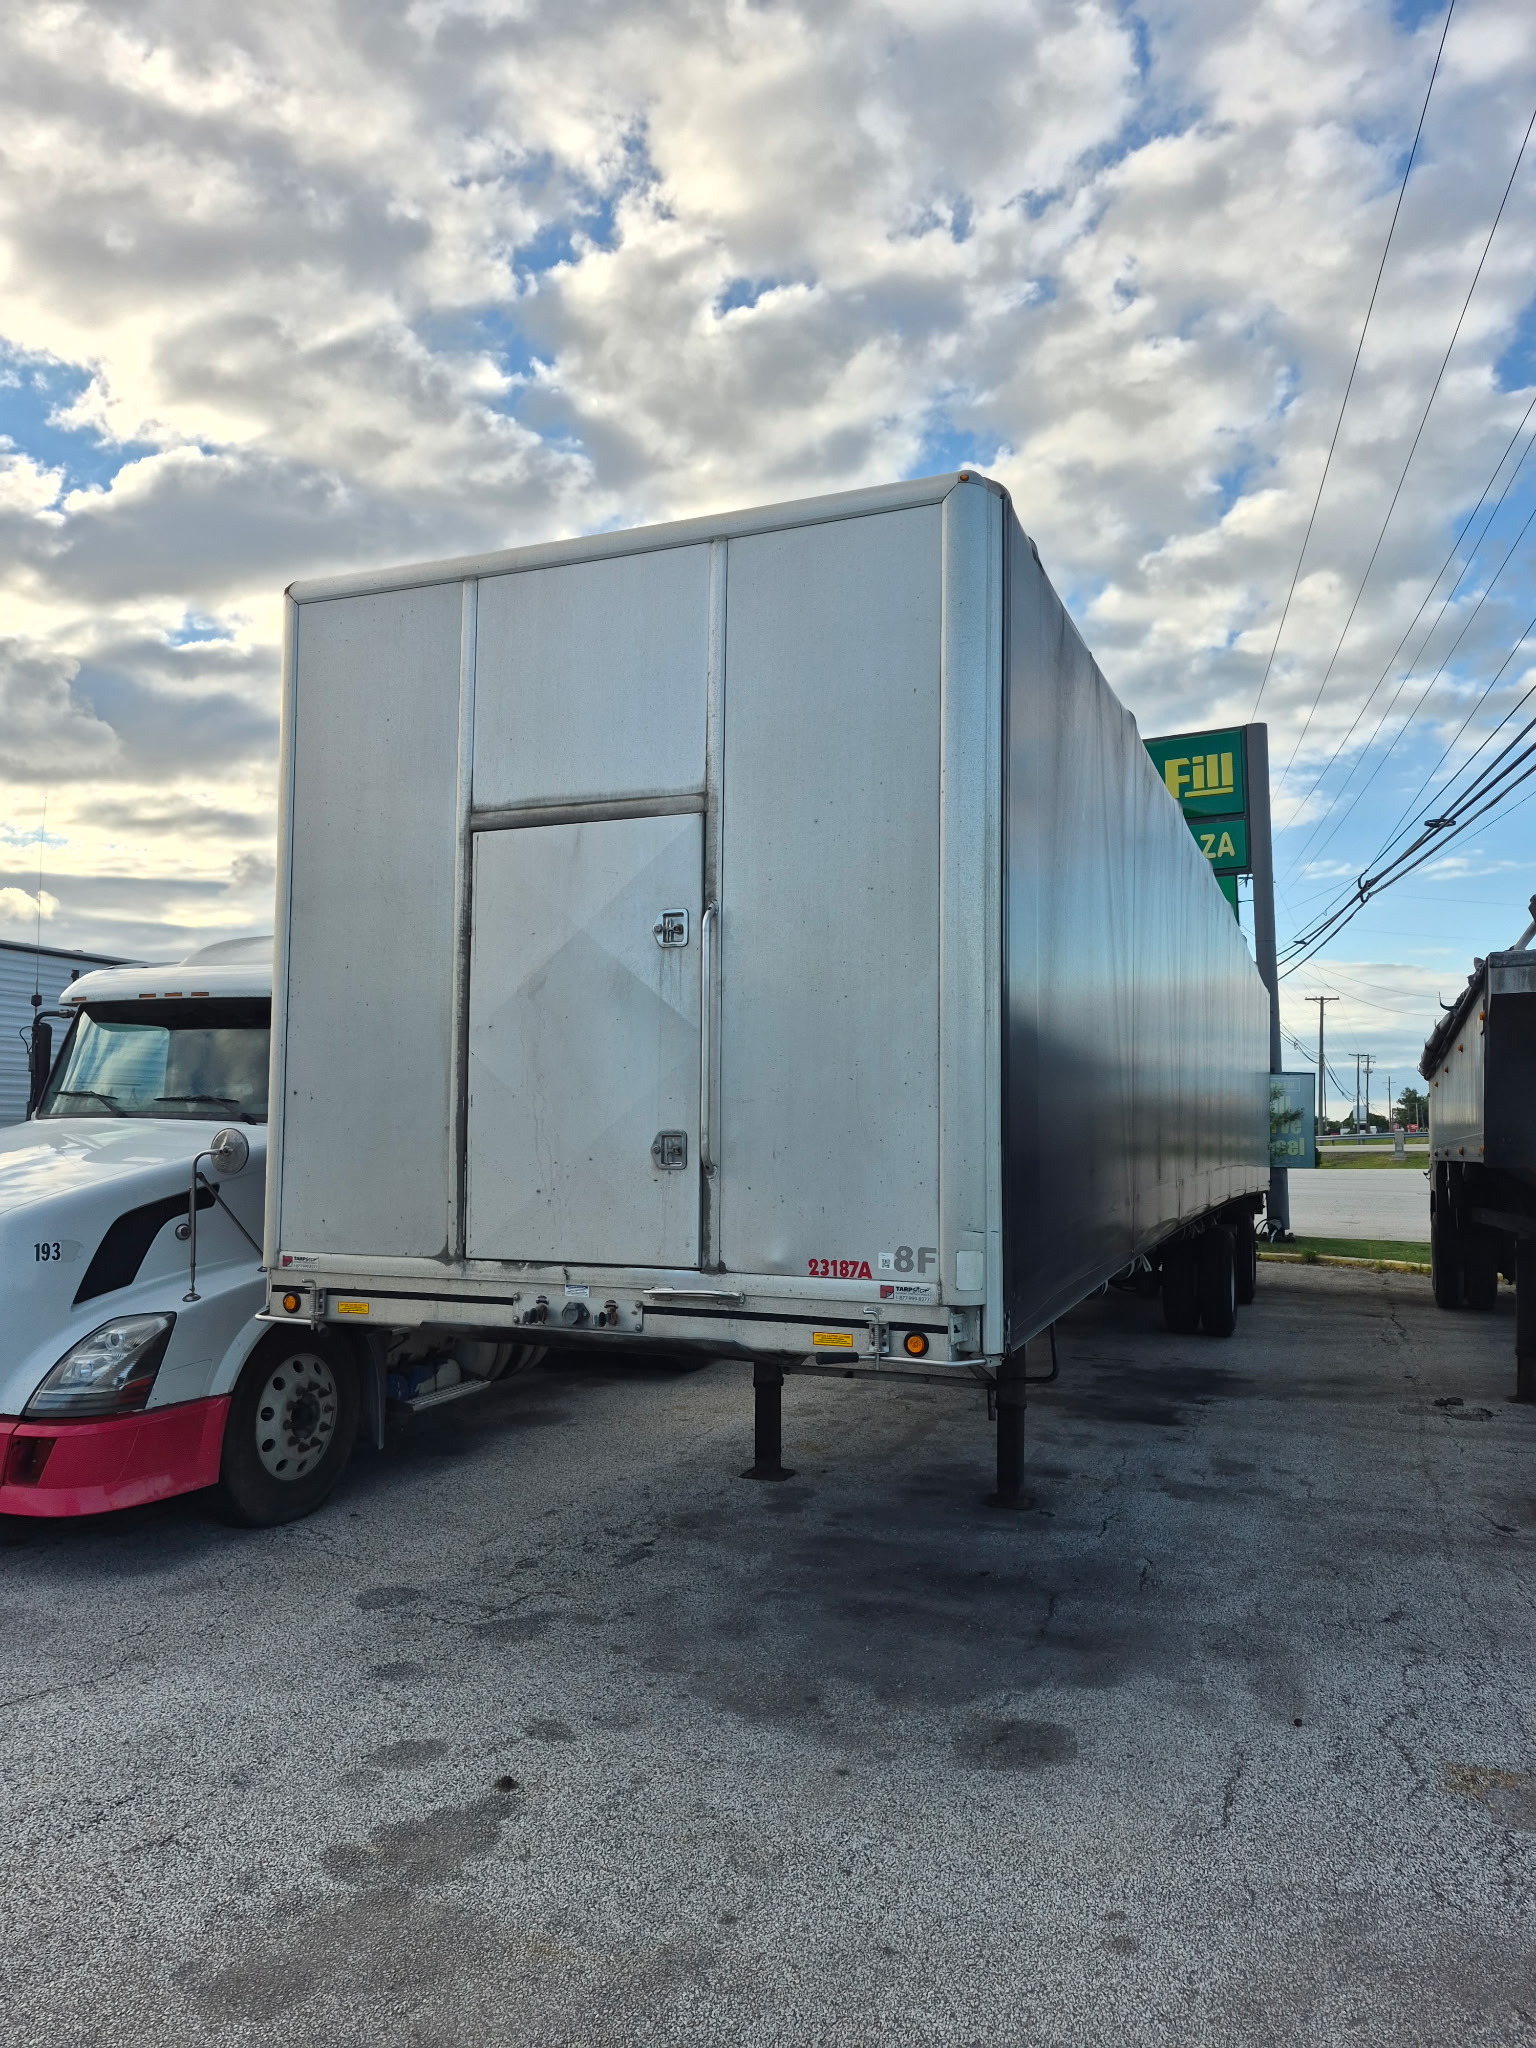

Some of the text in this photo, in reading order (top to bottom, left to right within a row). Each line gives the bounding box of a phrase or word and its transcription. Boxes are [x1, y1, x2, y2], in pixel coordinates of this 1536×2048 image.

[1165, 752, 1233, 799] Fill
[34, 1242, 61, 1262] 193
[894, 1245, 937, 1274] 8F
[808, 1258, 873, 1280] 23187A
